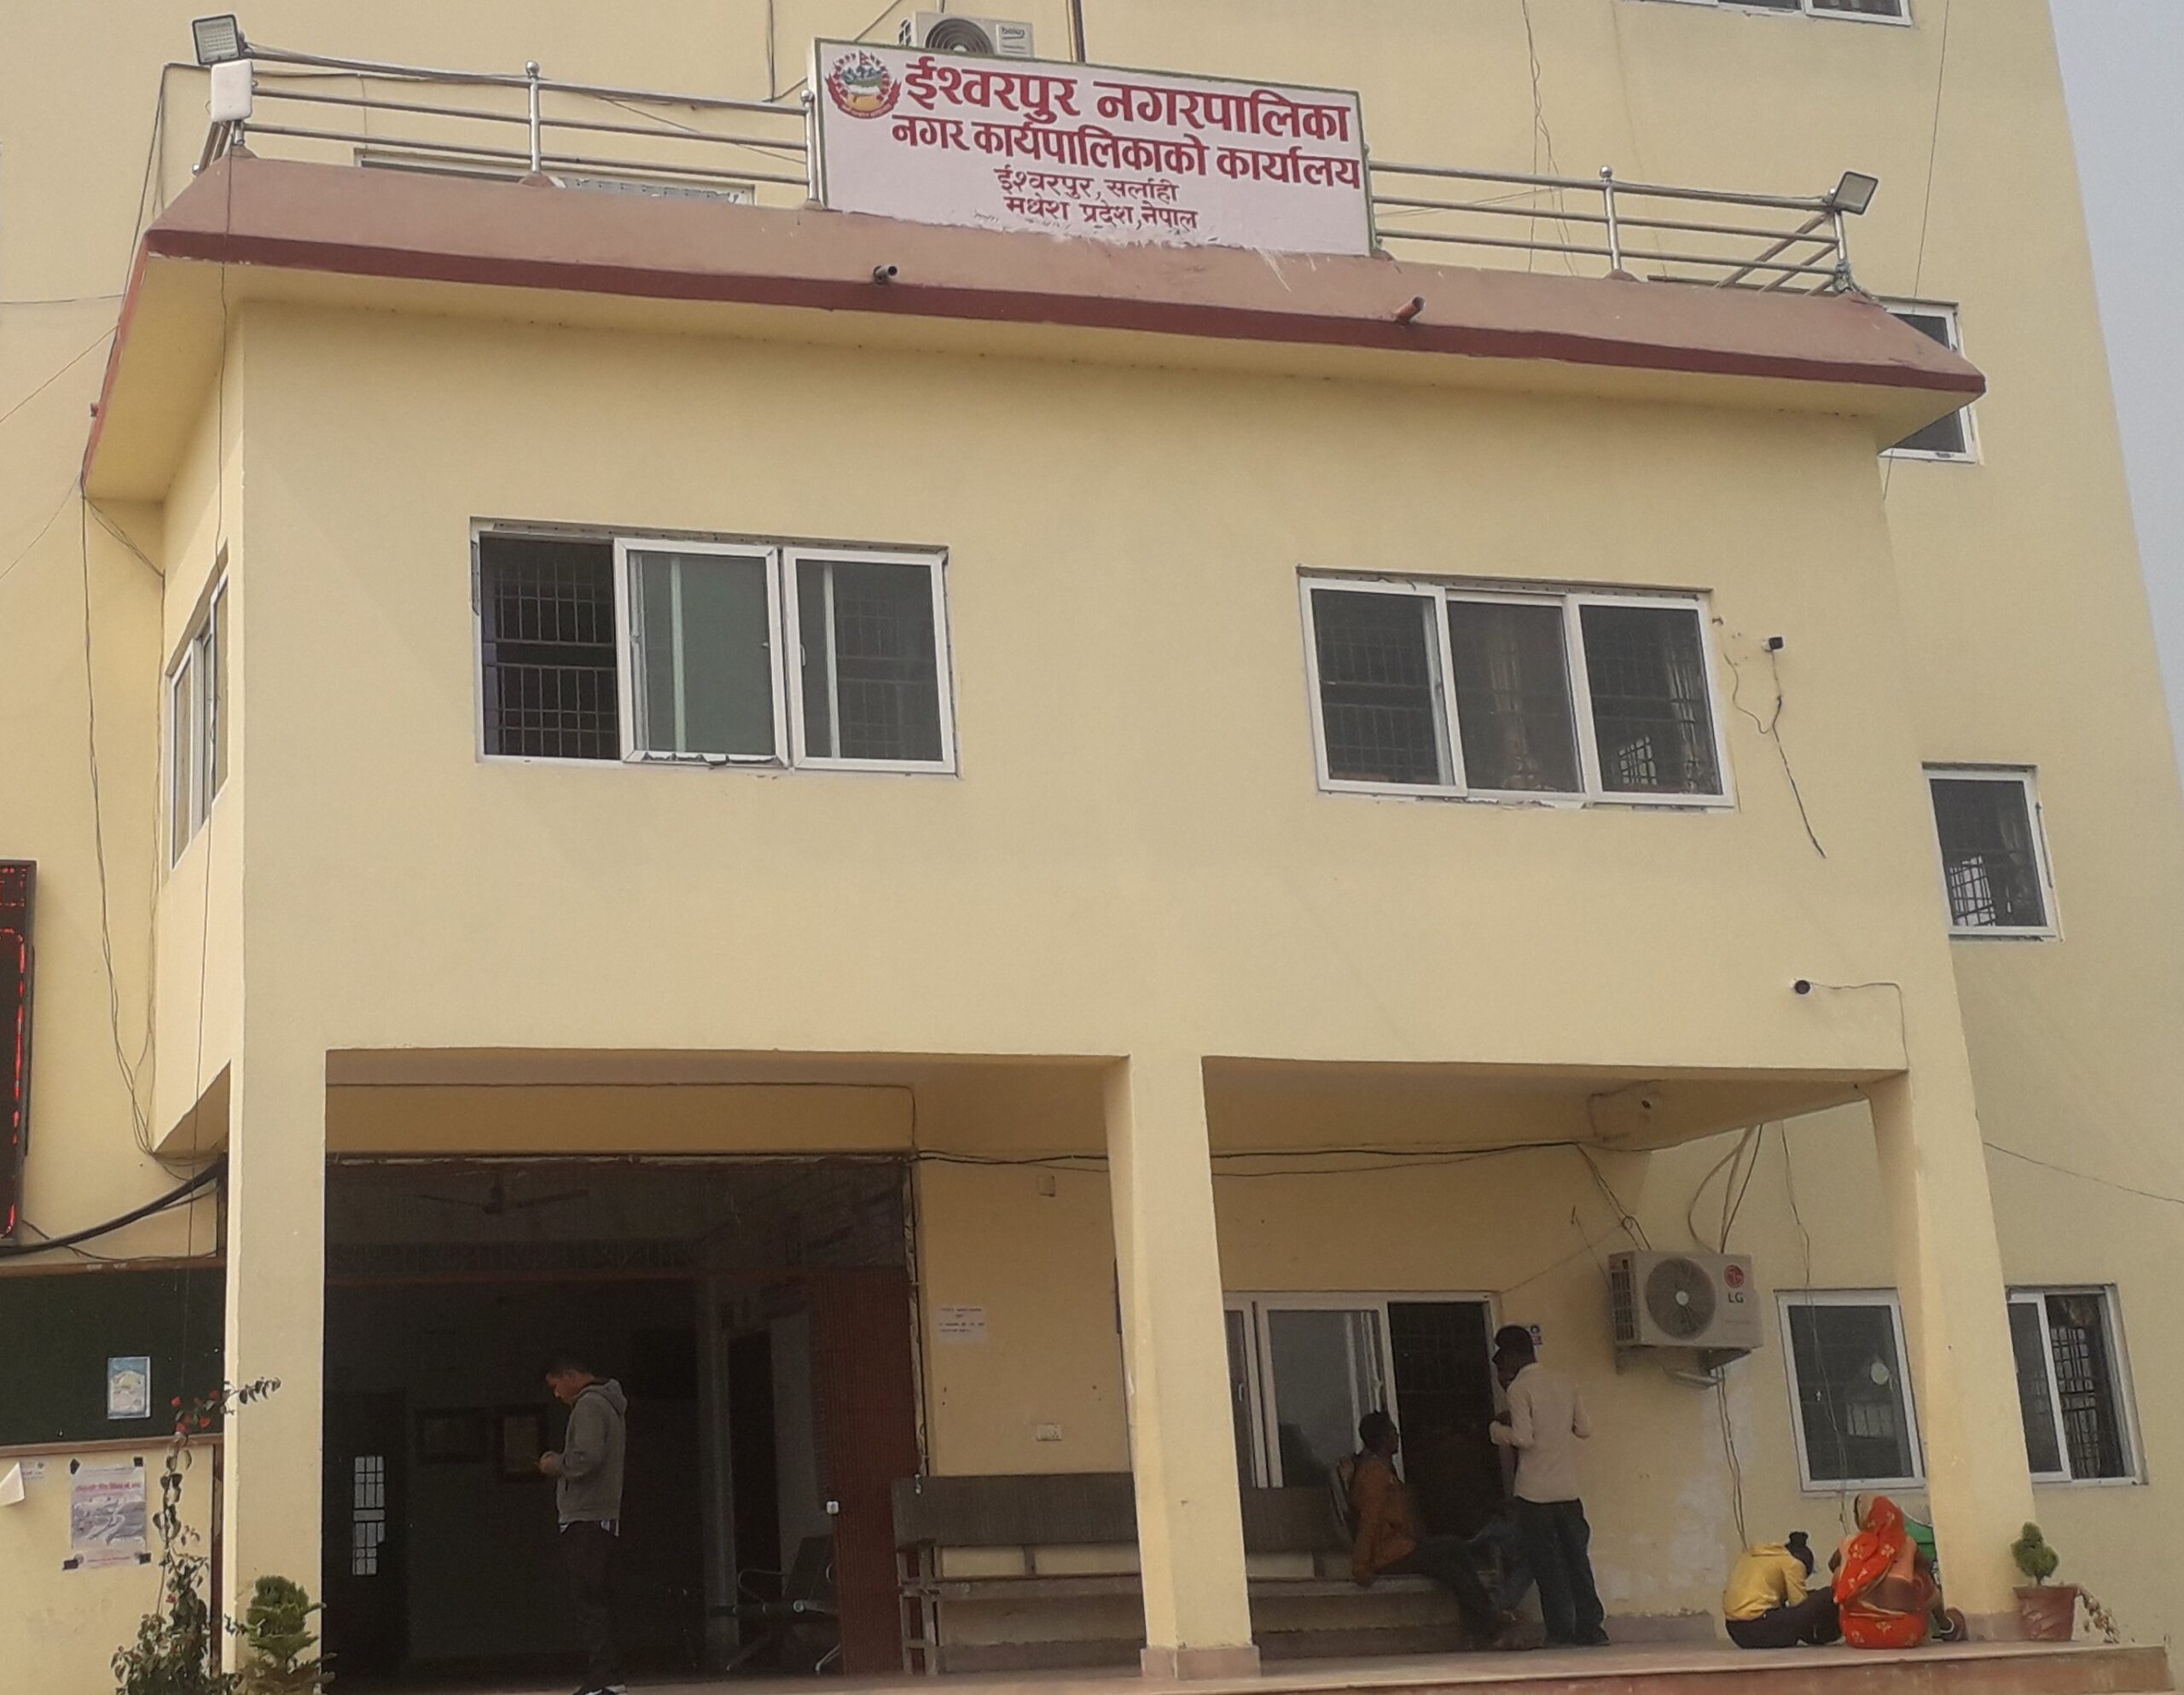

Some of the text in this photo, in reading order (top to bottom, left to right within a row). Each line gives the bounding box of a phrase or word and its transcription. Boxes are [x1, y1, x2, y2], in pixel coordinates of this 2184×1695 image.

[905, 55, 1350, 142] ईश्वरपुर नगरपालिका
[892, 114, 1361, 189] नगर कार्यपालिकाको कार्यालय
[994, 164, 1179, 204] ईश्वरपुर, सर्लाही
[1003, 193, 1070, 219] मधेश
[1728, 1292, 1744, 1303] LG
